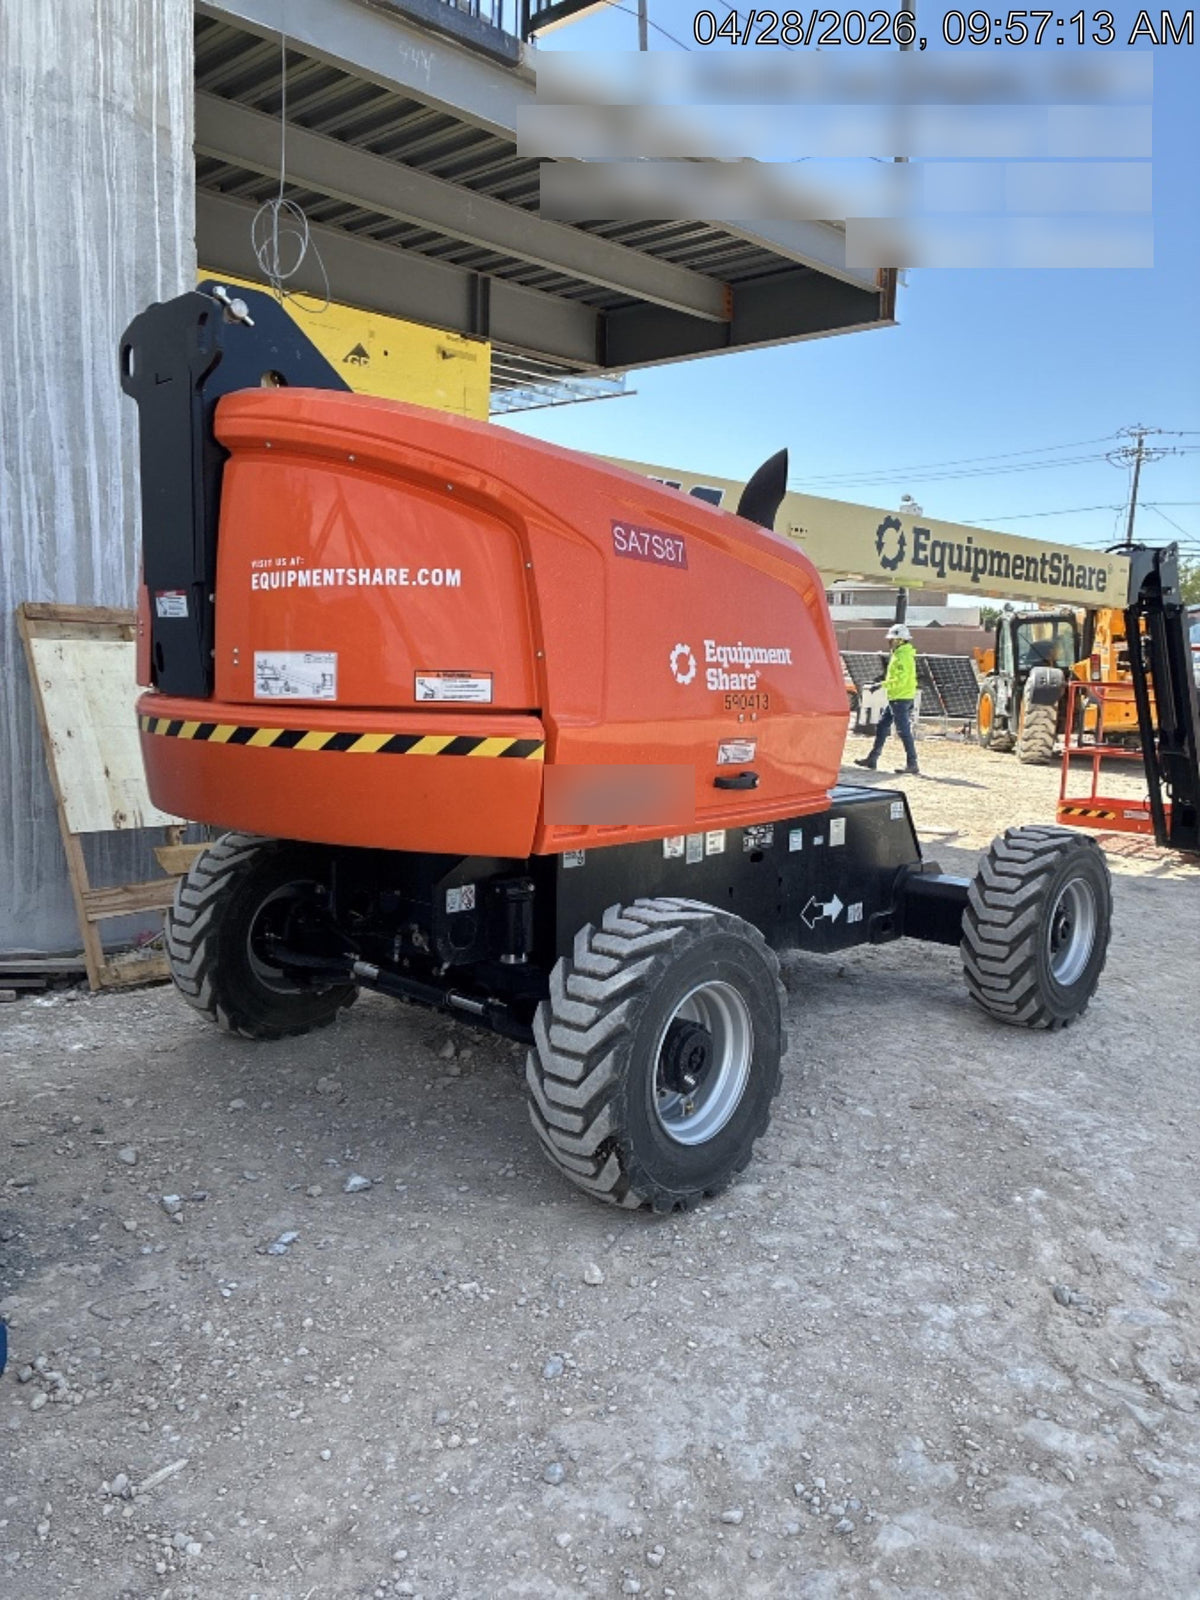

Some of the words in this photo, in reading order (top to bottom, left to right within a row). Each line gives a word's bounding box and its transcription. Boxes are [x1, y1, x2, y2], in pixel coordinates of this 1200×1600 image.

[613, 526, 684, 562] SA7S87
[251, 560, 272, 569] VISIT
[275, 557, 287, 566] US
[911, 526, 1107, 593] EquipmentShare
[251, 568, 462, 590] EQUIPMENTSHARE.COM
[703, 639, 792, 669] Equipment
[706, 668, 757, 691] Share
[724, 694, 769, 710] 590413
